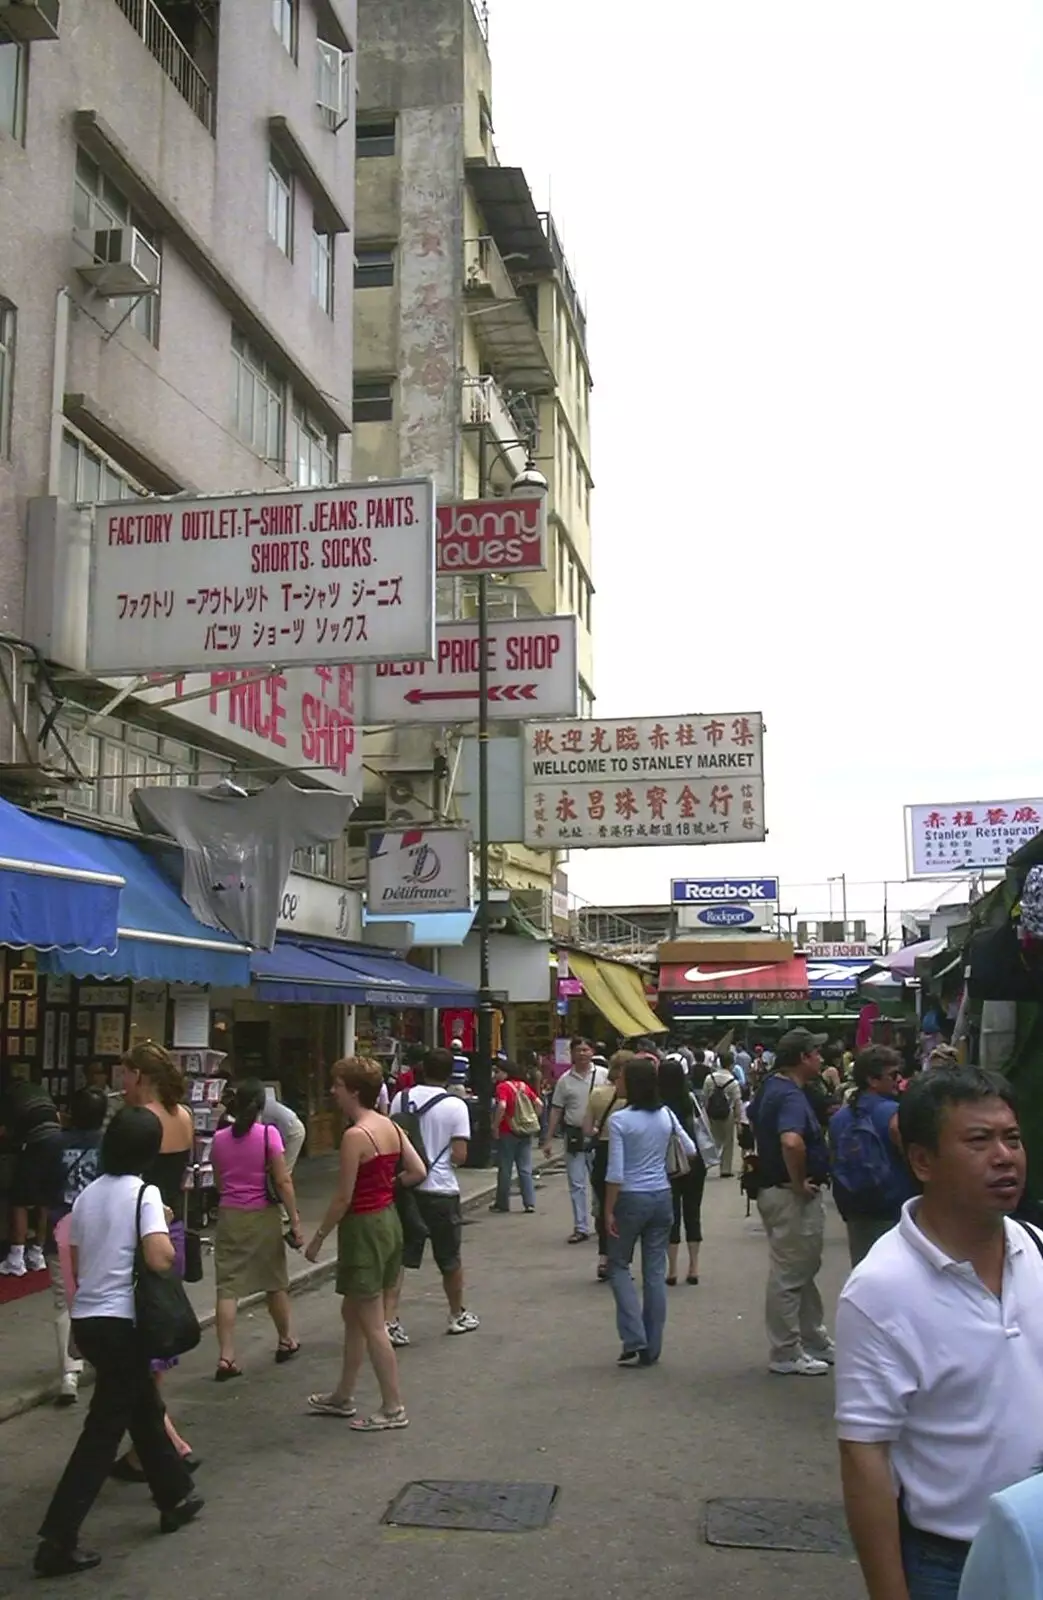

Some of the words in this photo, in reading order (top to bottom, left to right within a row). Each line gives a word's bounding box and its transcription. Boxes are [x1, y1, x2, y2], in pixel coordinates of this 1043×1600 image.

[108, 513, 173, 546] FACTORY
[437, 637, 497, 674] PRICE
[506, 634, 560, 671] SHOP
[302, 692, 354, 776] SHOP
[533, 759, 606, 775] WELLCOME
[611, 757, 628, 772] TO
[632, 755, 693, 771] STANLEY
[697, 753, 754, 768] MARKET
[924, 829, 968, 841] Stanley
[975, 826, 1040, 838] Restaurant
[382, 885, 454, 901] Délifrance
[685, 883, 765, 898] Reebok
[706, 910, 745, 924] Rockport
